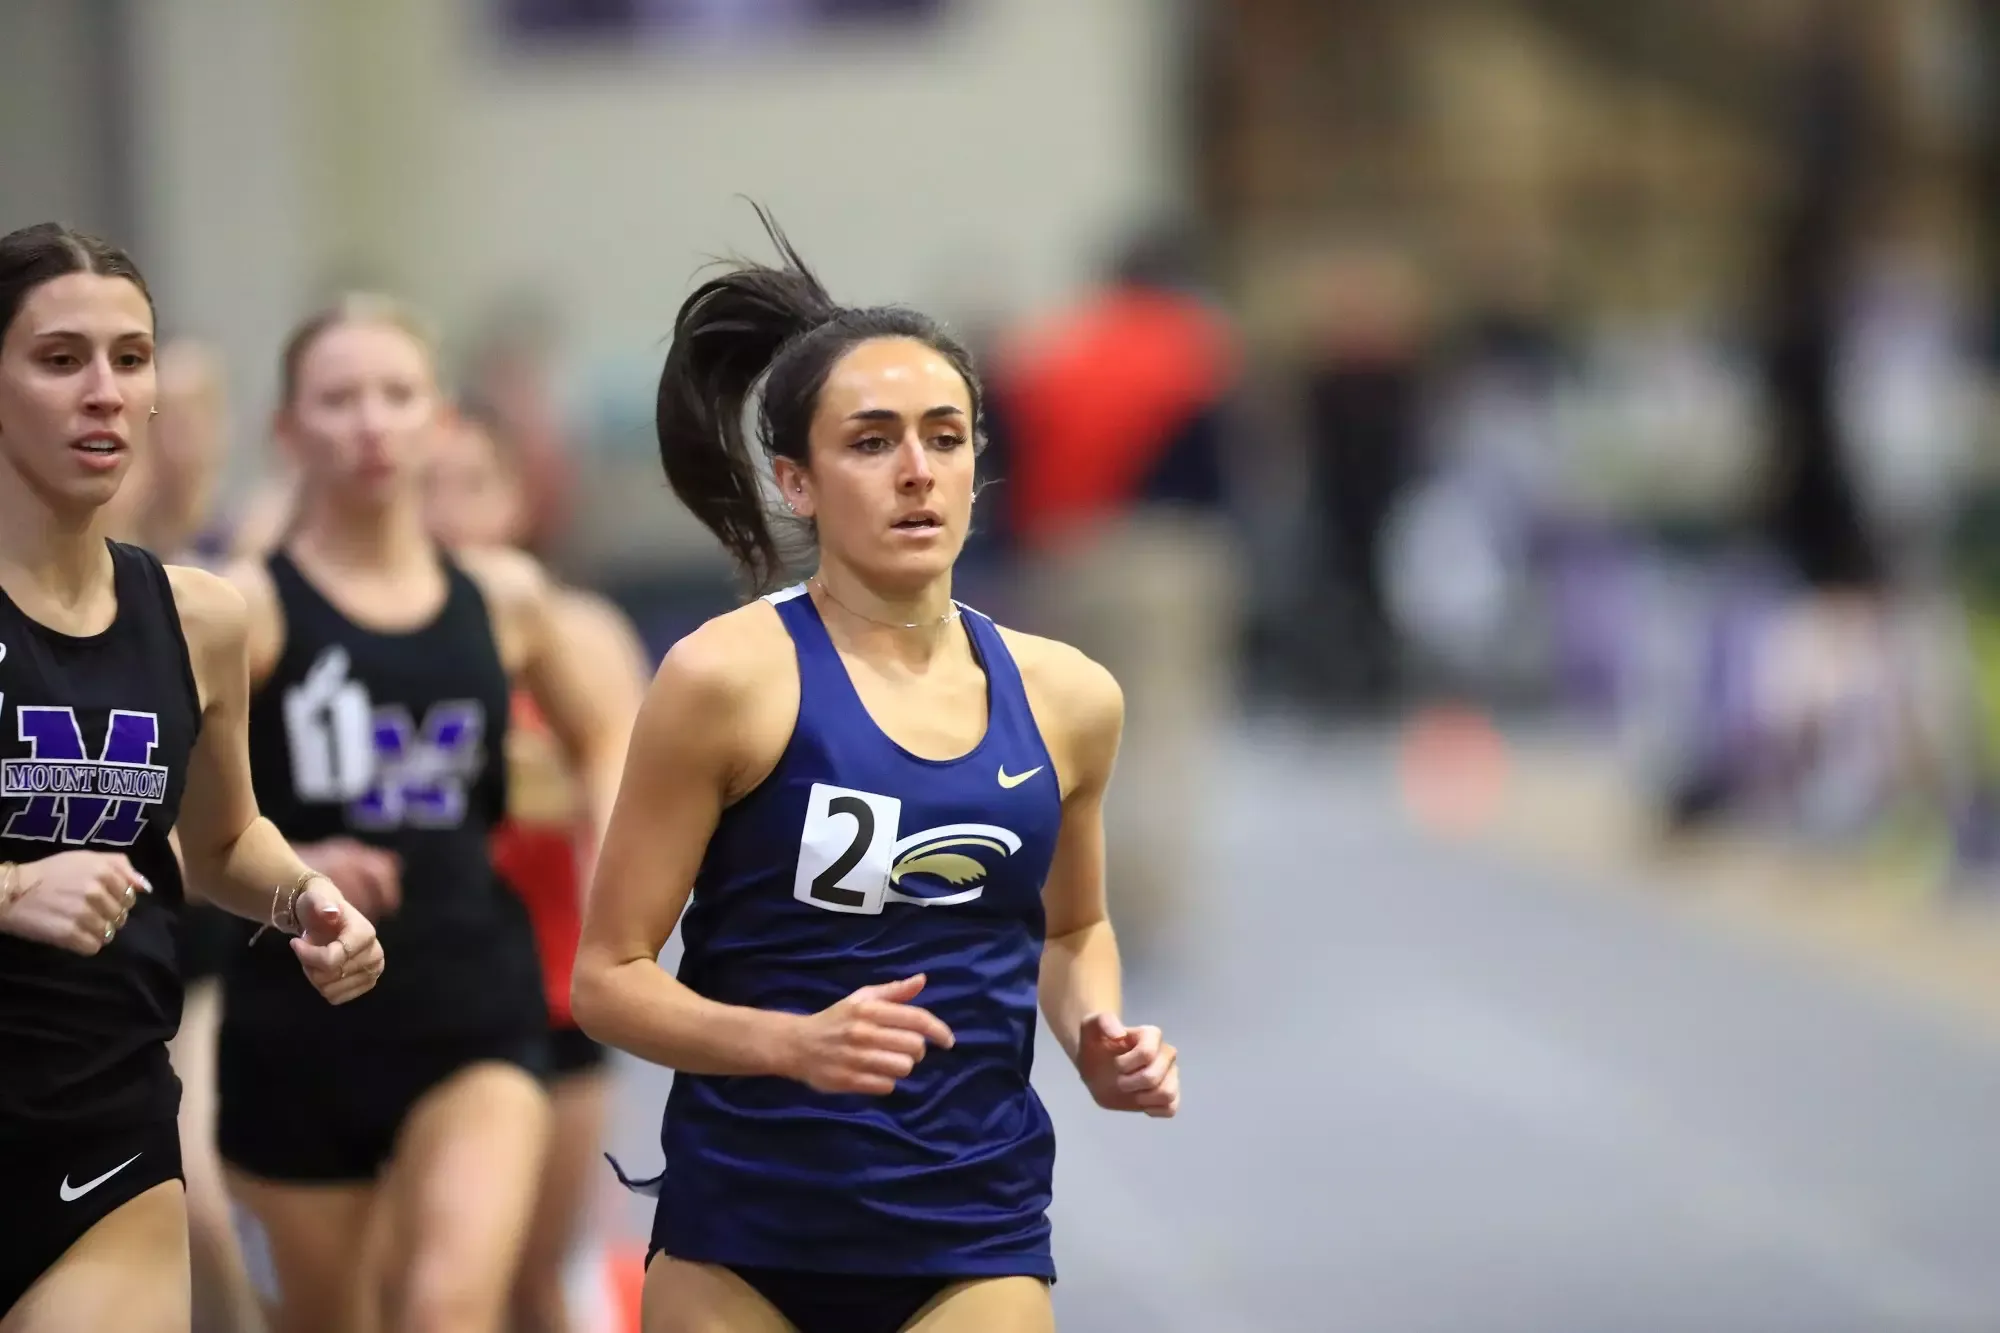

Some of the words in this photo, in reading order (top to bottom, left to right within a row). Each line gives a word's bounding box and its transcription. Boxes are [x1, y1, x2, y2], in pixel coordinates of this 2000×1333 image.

[6, 764, 97, 793] MOUNT
[98, 767, 165, 798] UNION
[810, 796, 875, 908] 2
